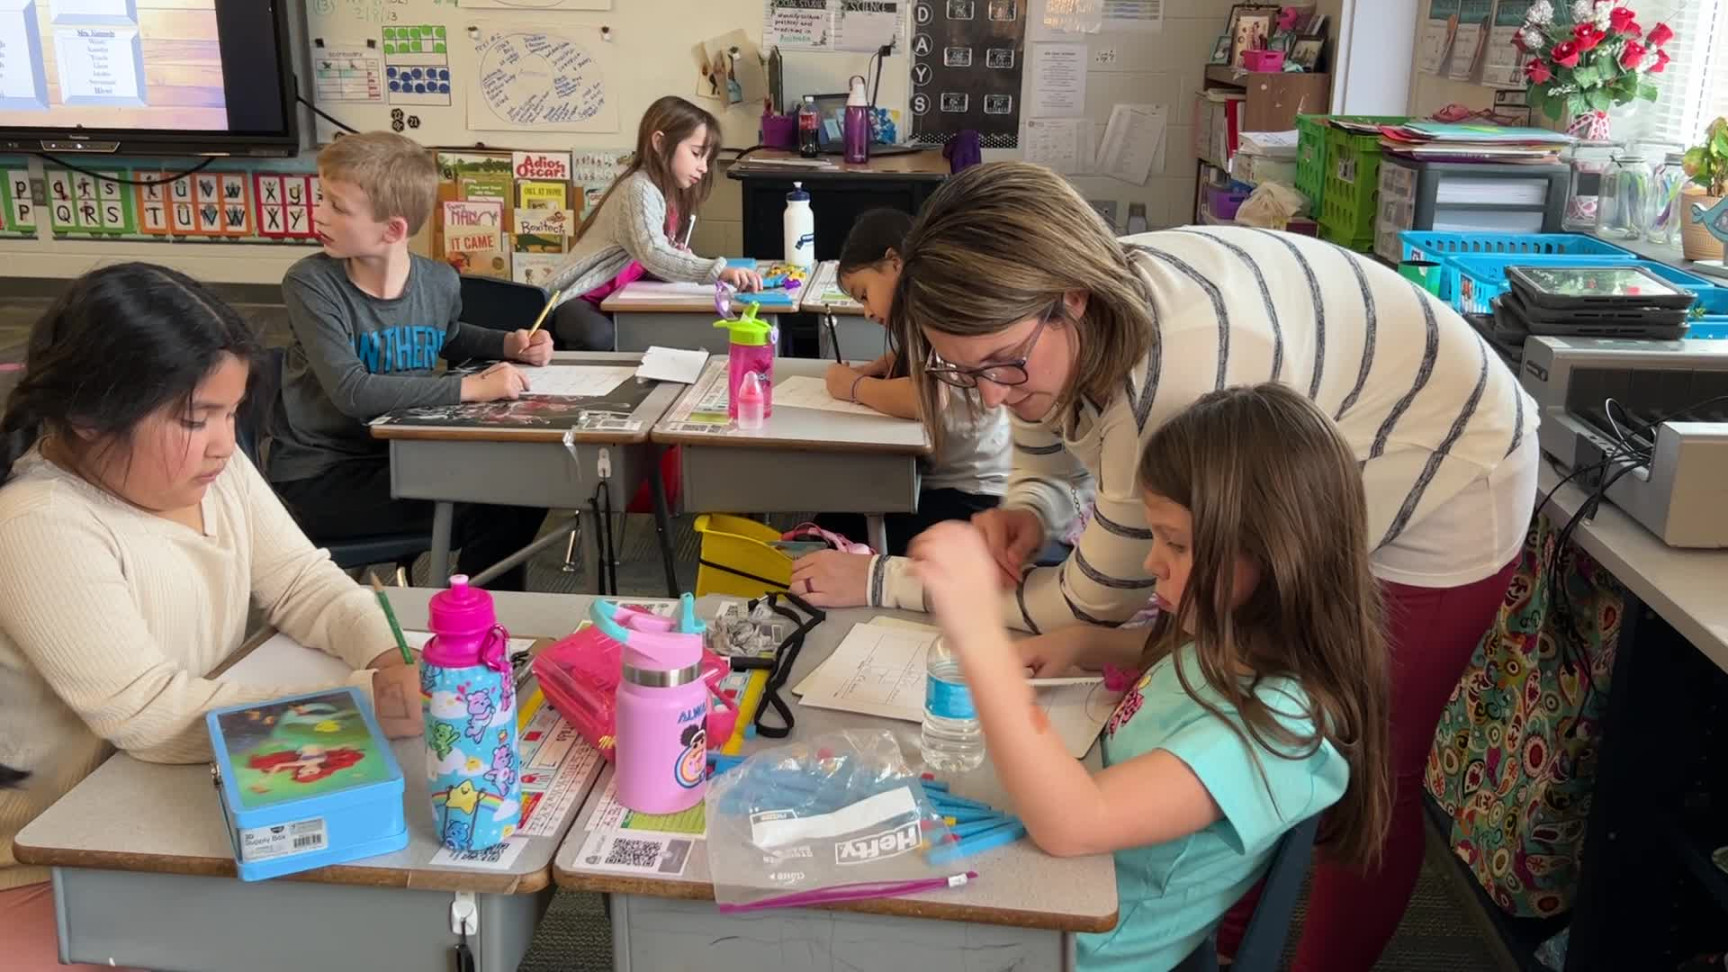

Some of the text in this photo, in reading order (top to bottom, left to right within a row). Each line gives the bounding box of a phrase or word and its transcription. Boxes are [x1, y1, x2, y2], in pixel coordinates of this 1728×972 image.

[850, 1, 886, 13] SCIENCE
[516, 163, 566, 178] Oscar!
[15, 181, 27, 199] p
[105, 183, 114, 195] s
[19, 204, 30, 221] P
[56, 205, 71, 223] Q
[107, 206, 119, 223] S
[145, 207, 162, 226] T
[178, 206, 191, 226] U
[225, 207, 245, 227] W
[266, 207, 280, 230] X
[451, 235, 494, 250] IT CAME
[841, 826, 917, 859] Hefty
